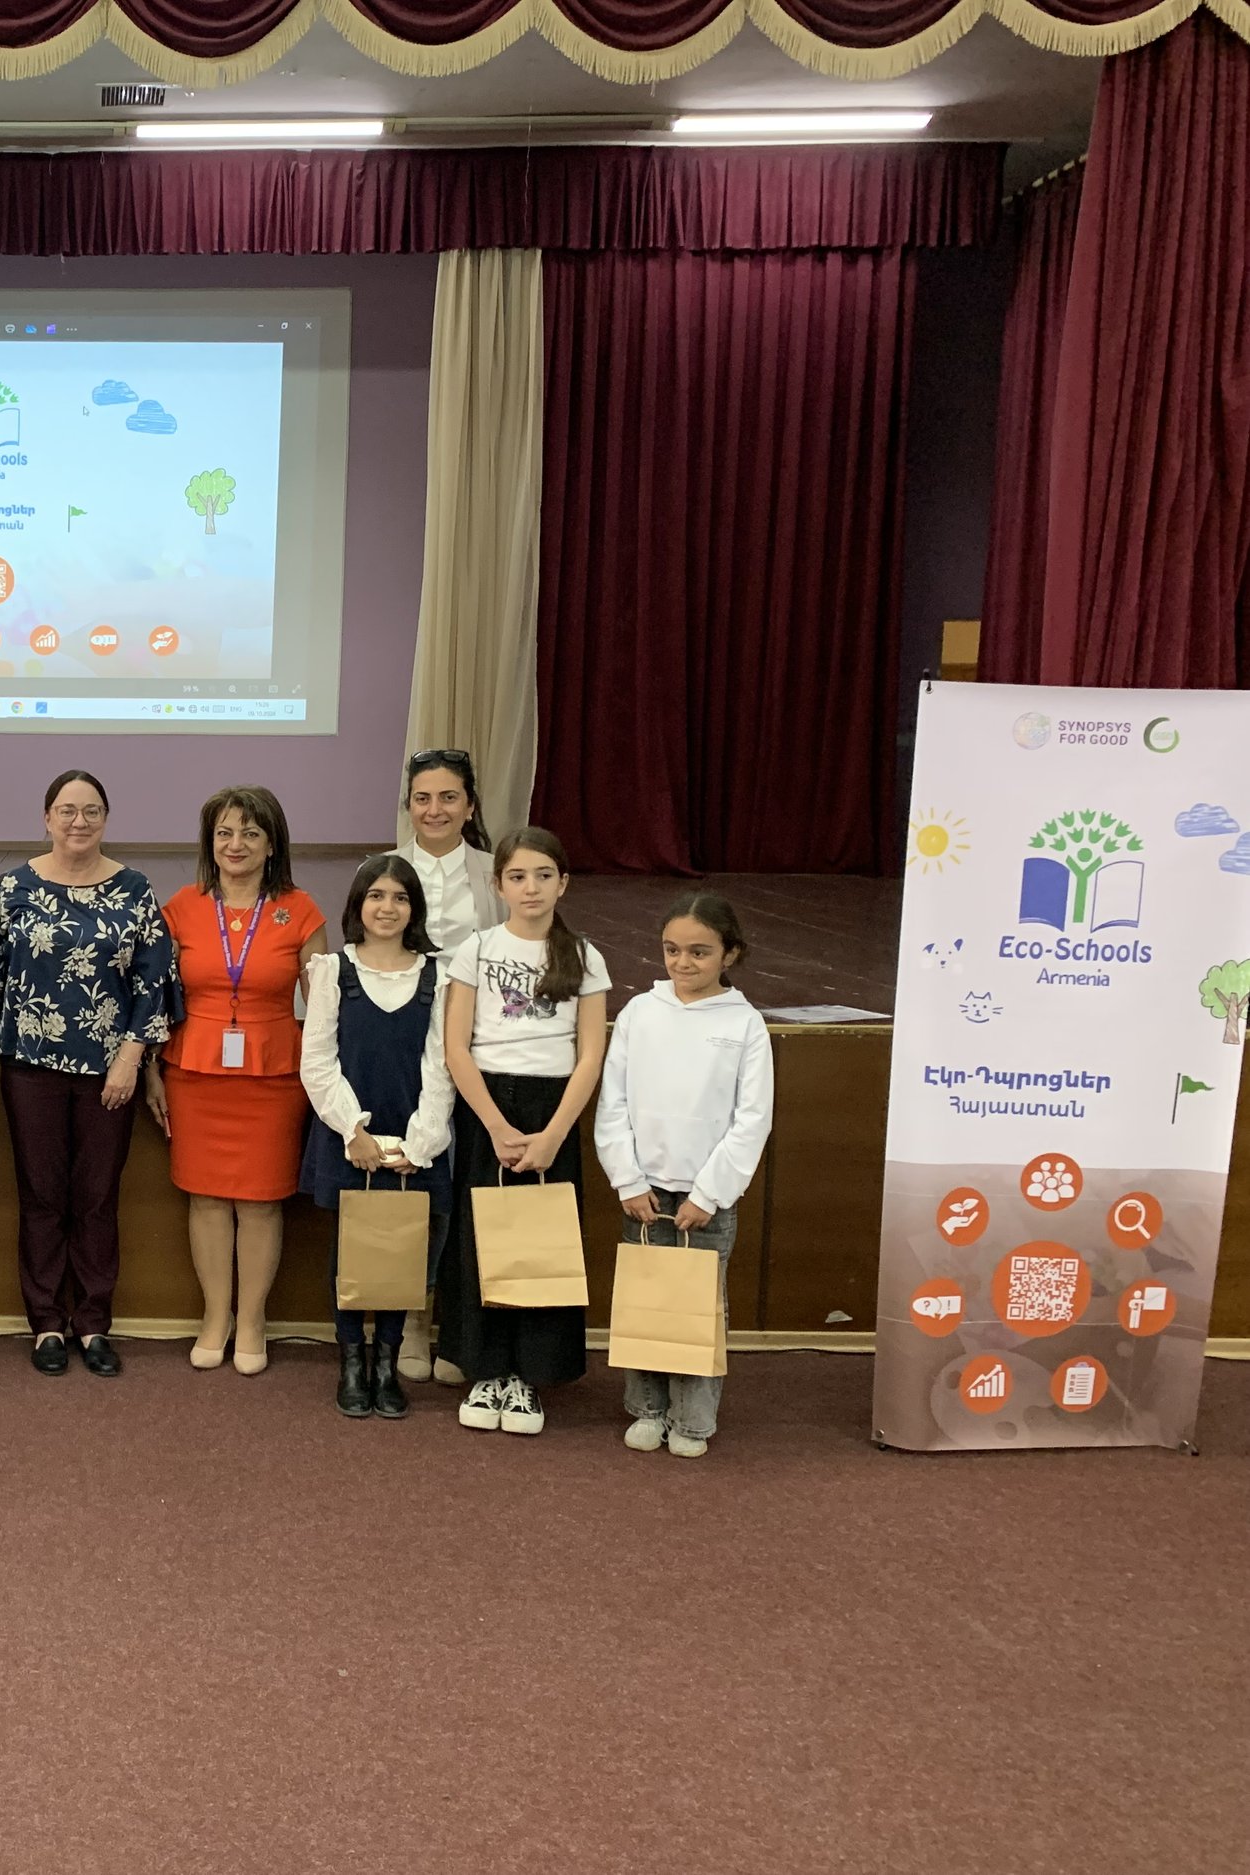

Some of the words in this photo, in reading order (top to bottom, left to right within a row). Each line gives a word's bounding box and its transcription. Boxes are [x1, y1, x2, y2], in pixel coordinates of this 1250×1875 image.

[1058, 720, 1132, 733] SYNOPSYS
[1059, 734, 1086, 745] FOR
[1089, 735, 1129, 746] GOOD
[999, 935, 1152, 964] Eco-Schools
[1036, 968, 1110, 987] Armenia
[924, 1066, 1111, 1093] Էկո-Դպրոցներ
[949, 1096, 1085, 1118] Հայաստան
